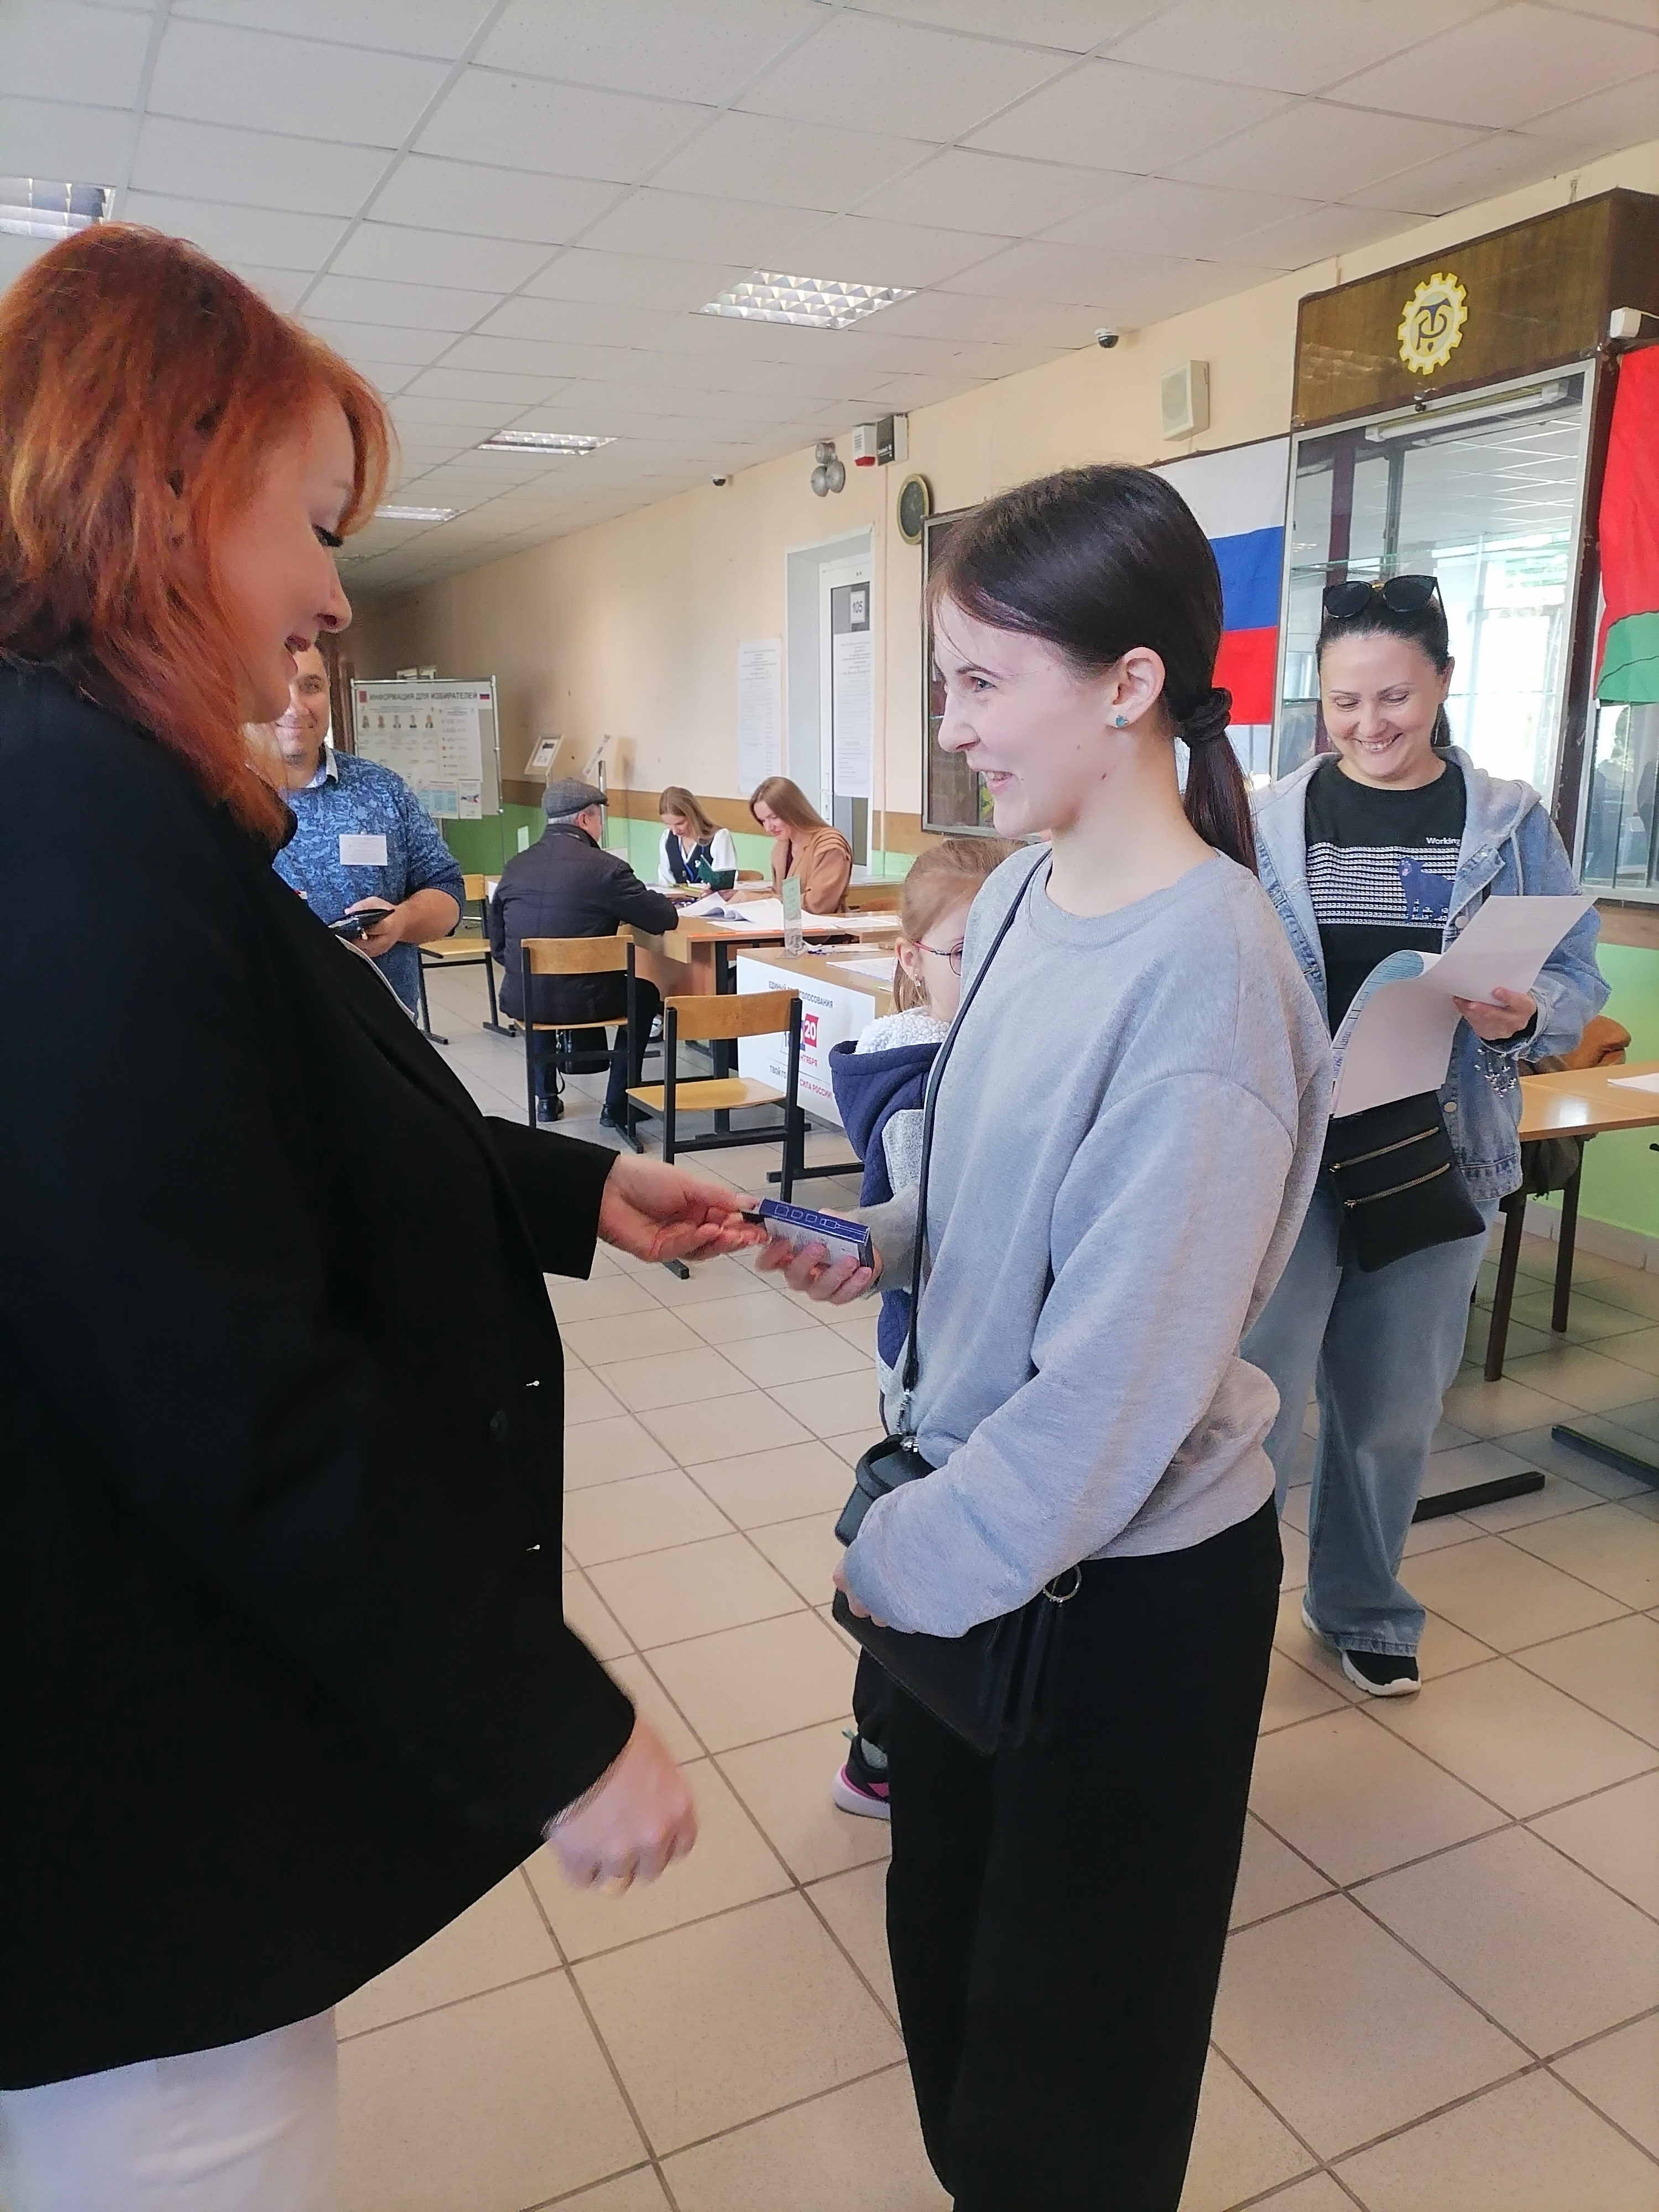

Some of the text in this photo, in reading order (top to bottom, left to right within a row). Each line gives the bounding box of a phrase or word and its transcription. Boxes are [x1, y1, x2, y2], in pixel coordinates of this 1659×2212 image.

[853, 601, 863, 613] 105
[369, 690, 477, 701] ИНФОРМАЦИЯ ДЛЯ ИЗБИРАТЕЛЕЙ
[805, 1020, 817, 1041] 20
[769, 1065, 781, 1076] ТВОЙ
[800, 1078, 812, 1091] СИЛА
